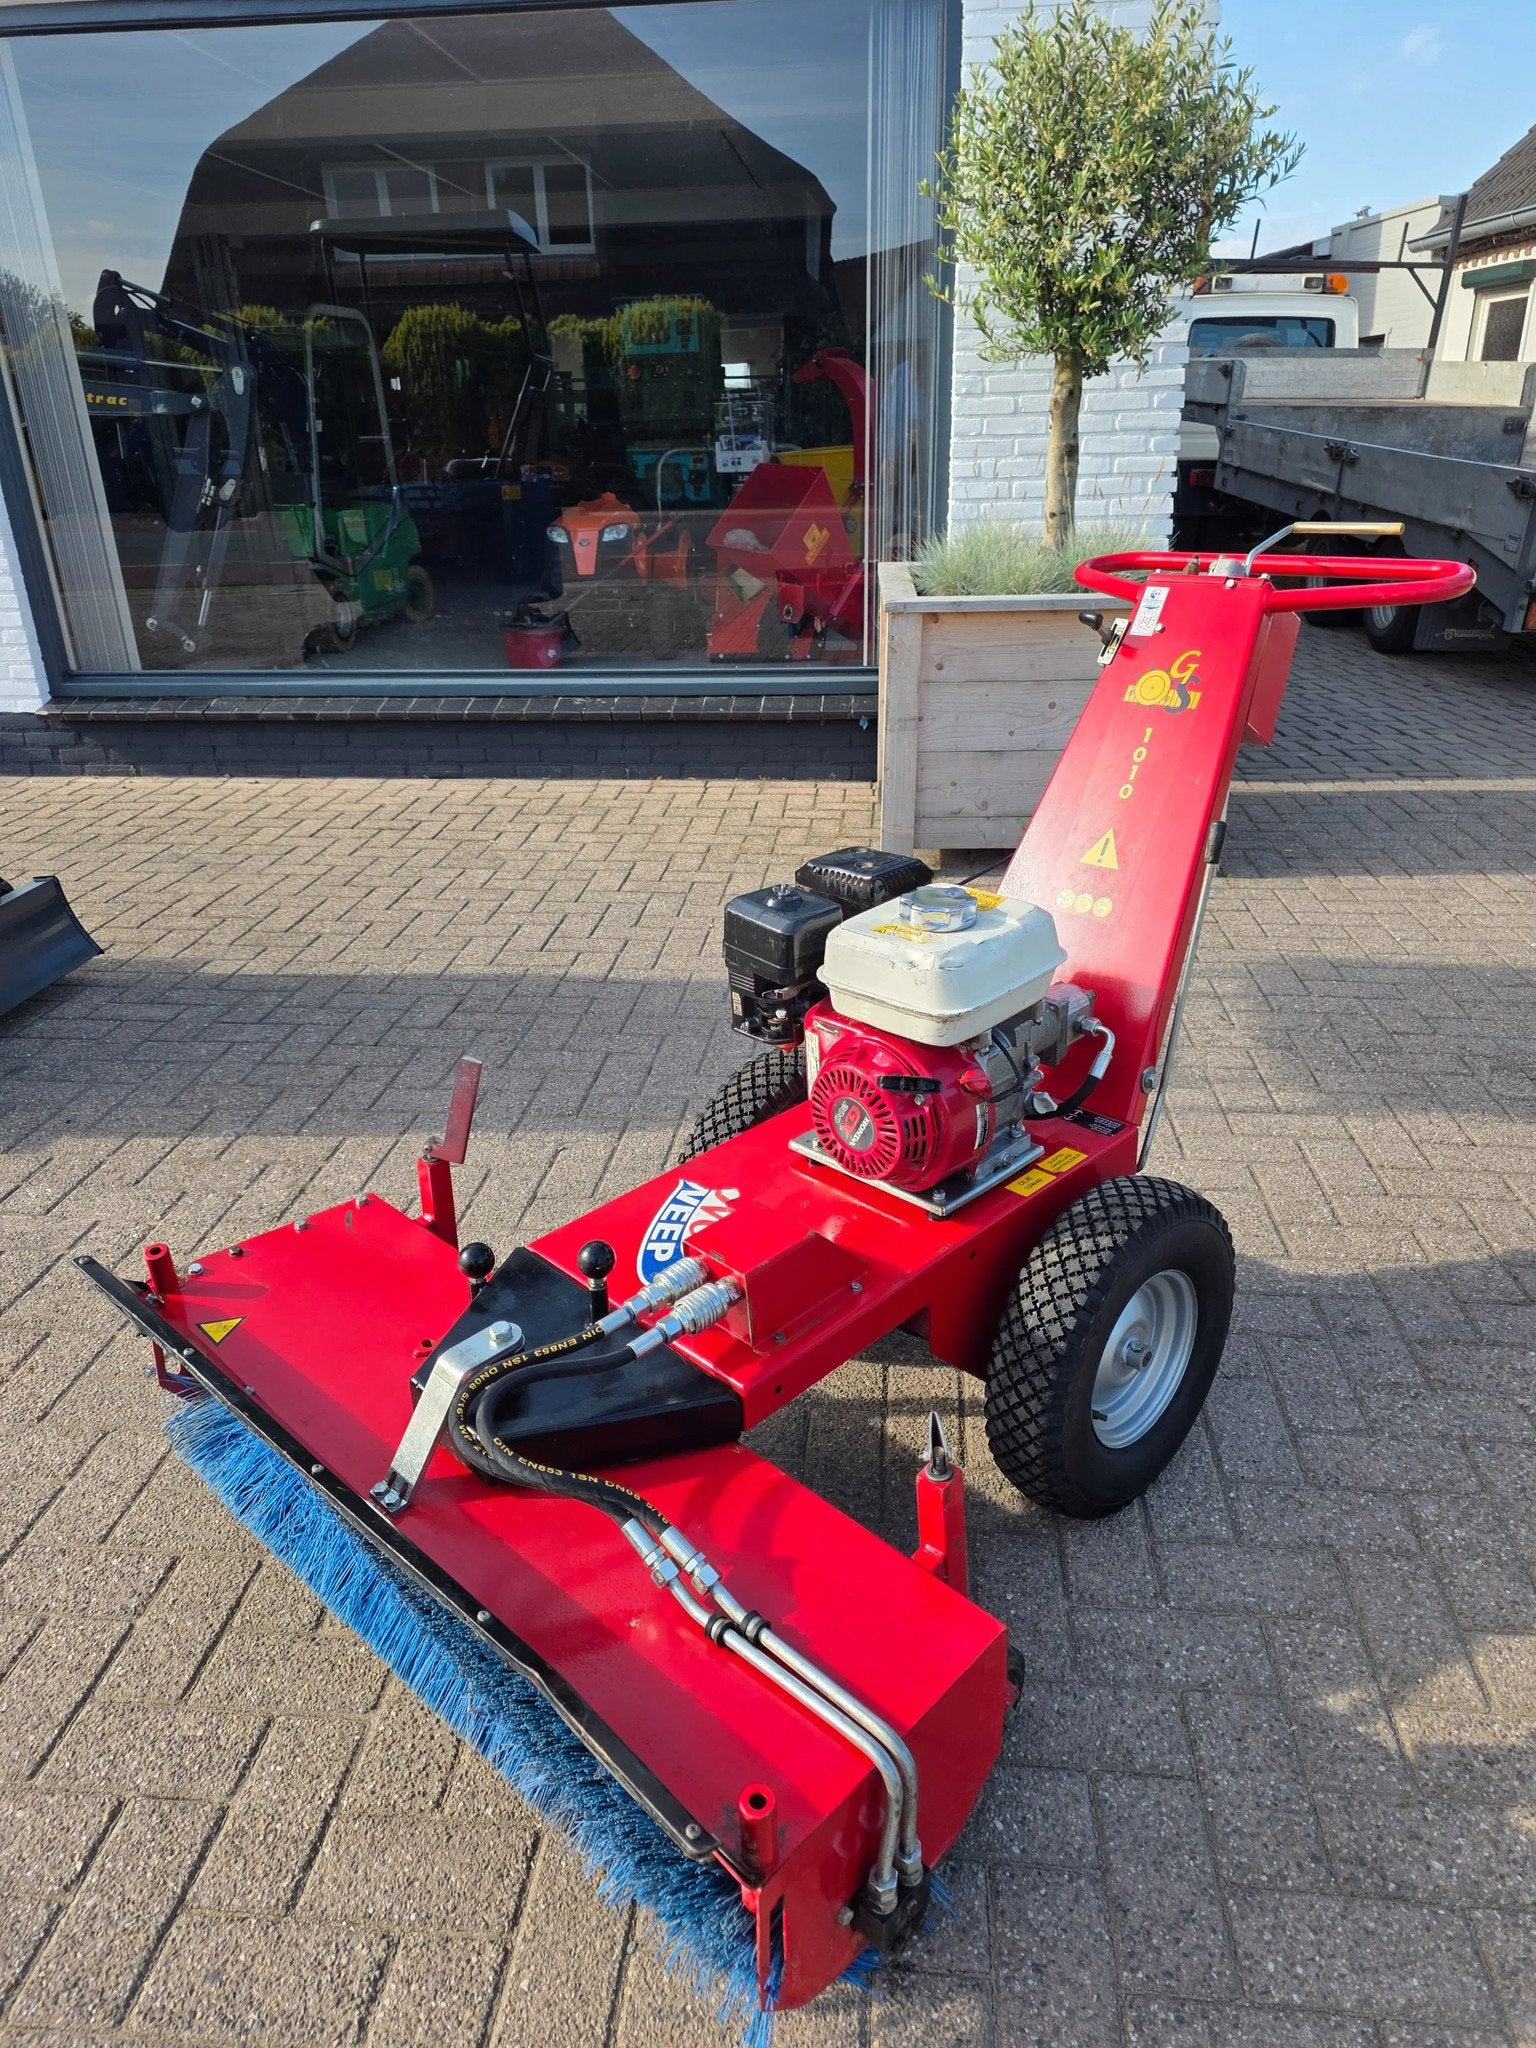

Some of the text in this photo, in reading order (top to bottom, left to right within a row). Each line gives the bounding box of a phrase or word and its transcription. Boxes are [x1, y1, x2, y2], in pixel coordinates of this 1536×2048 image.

[1118, 727, 1153, 800] 1010
[849, 1116, 870, 1146] HONDA
[646, 1180, 710, 1261] NEEP
[502, 1354, 529, 1369] 1SN
[533, 1338, 578, 1358] EN853
[468, 1366, 499, 1390] DN08
[493, 1437, 514, 1457] DIN
[518, 1456, 563, 1477] EN853
[570, 1472, 599, 1484] 1SN
